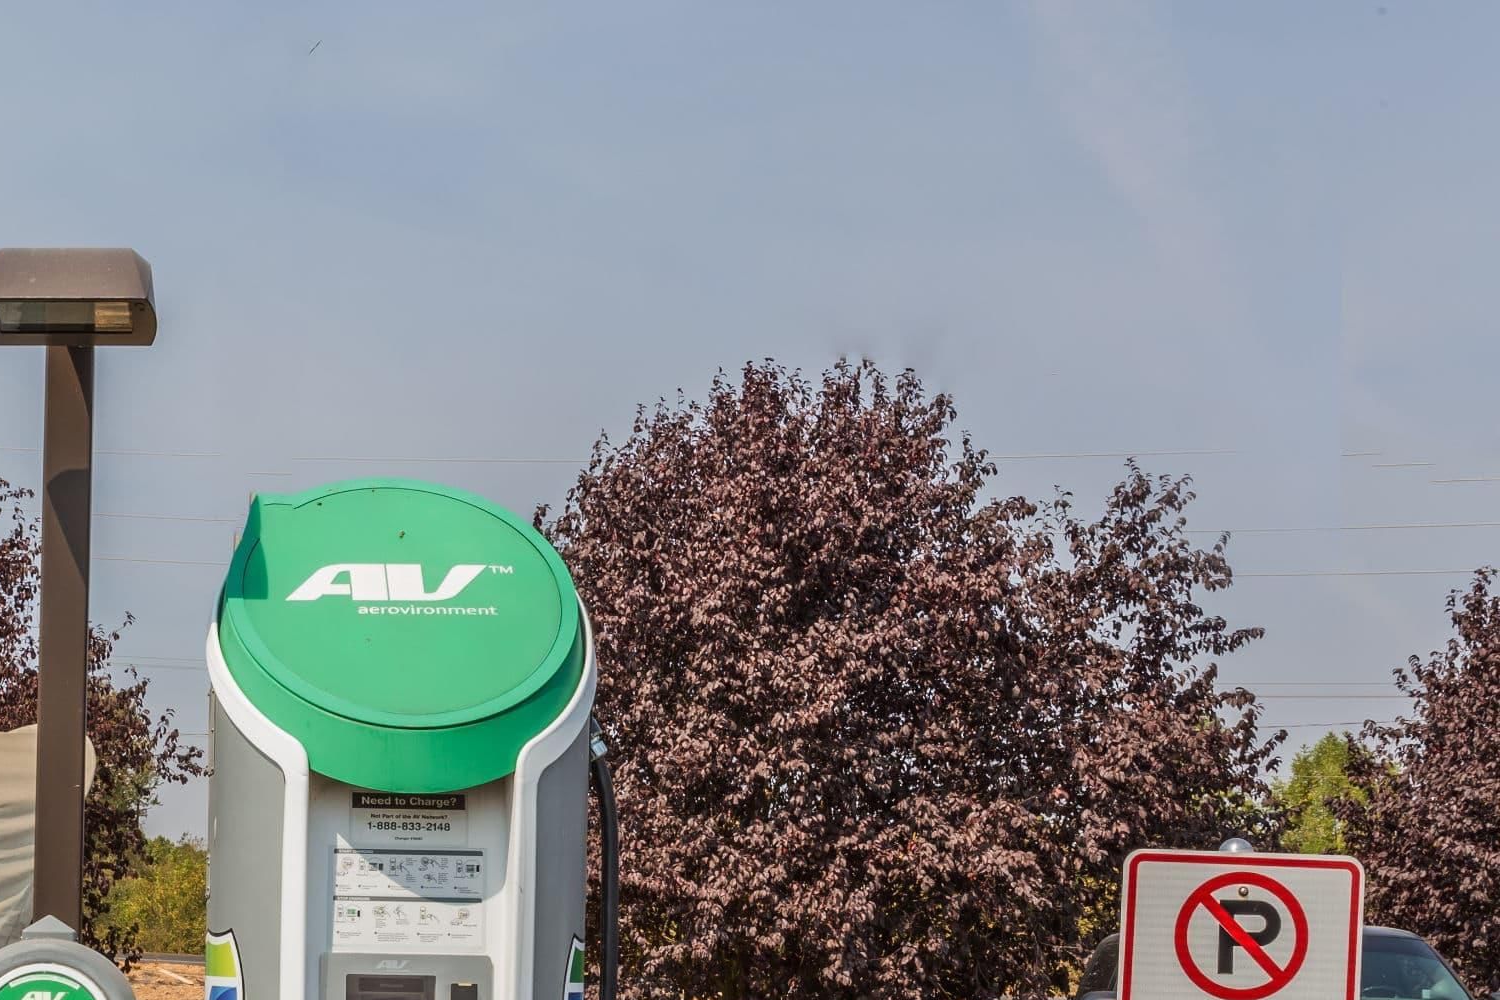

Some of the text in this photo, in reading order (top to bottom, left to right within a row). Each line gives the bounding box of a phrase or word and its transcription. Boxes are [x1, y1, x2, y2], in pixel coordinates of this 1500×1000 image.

[285, 563, 487, 601] AV
[358, 605, 498, 616] aerovironment
[361, 795, 457, 808] Need to Charge?
[367, 821, 451, 832] 1-888-833-2148
